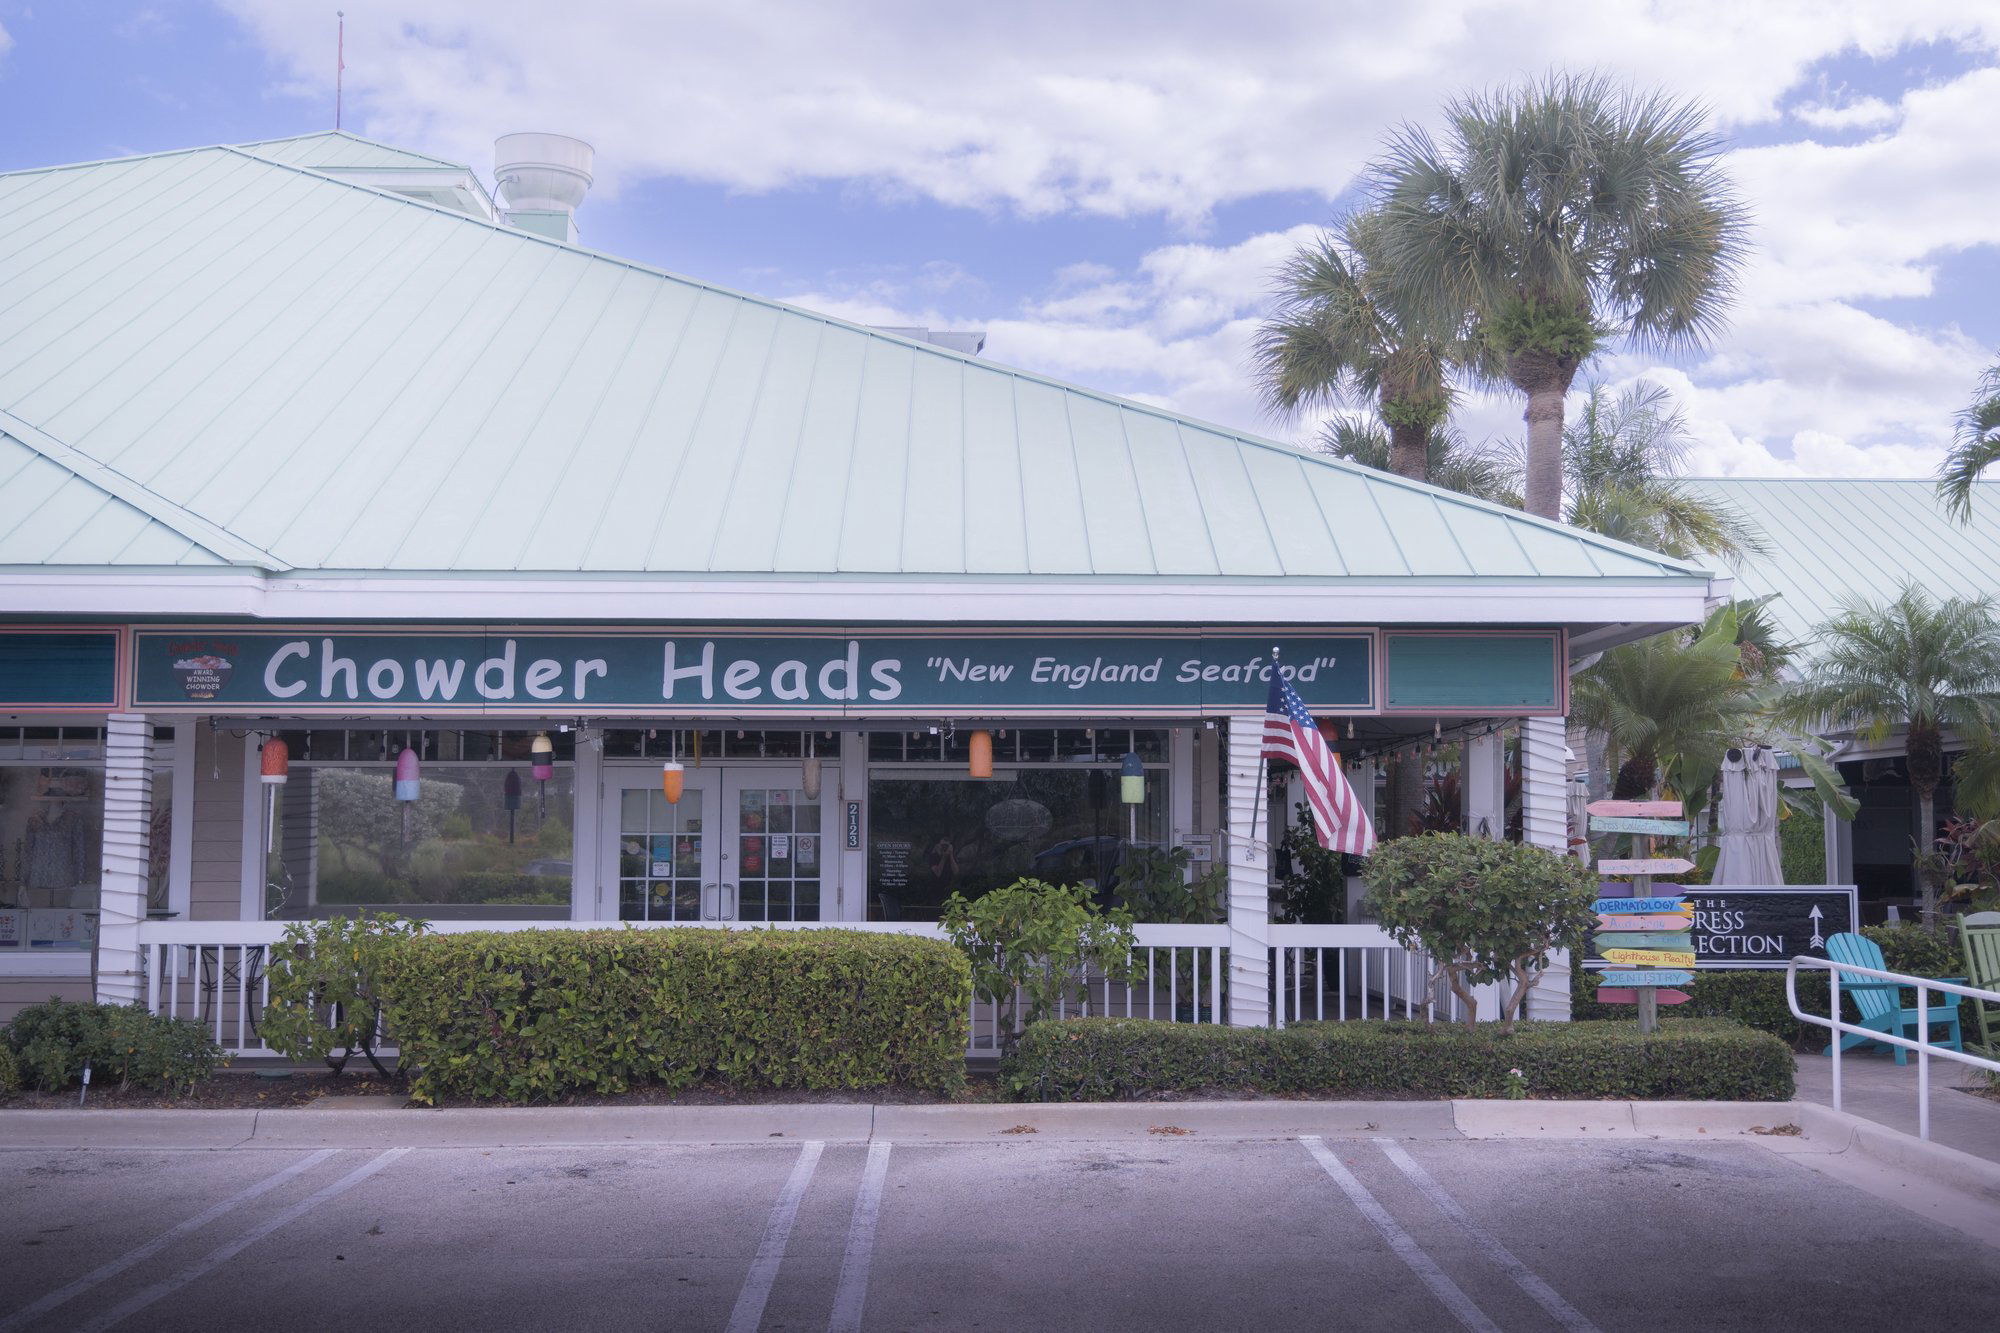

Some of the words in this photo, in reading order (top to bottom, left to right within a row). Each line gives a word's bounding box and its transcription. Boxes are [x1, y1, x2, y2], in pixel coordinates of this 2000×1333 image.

[264, 639, 608, 701] Chowder
[663, 641, 902, 701] Heads
[927, 657, 1014, 683] "New
[1031, 657, 1163, 689] England
[849, 803, 858, 847] 2123
[1600, 900, 1675, 912] DERMATOLOGY
[1694, 899, 1726, 908] THE
[1612, 951, 1660, 963] Lighthouse
[1663, 953, 1694, 966] Realty
[1609, 973, 1681, 983] DENTISTRY
